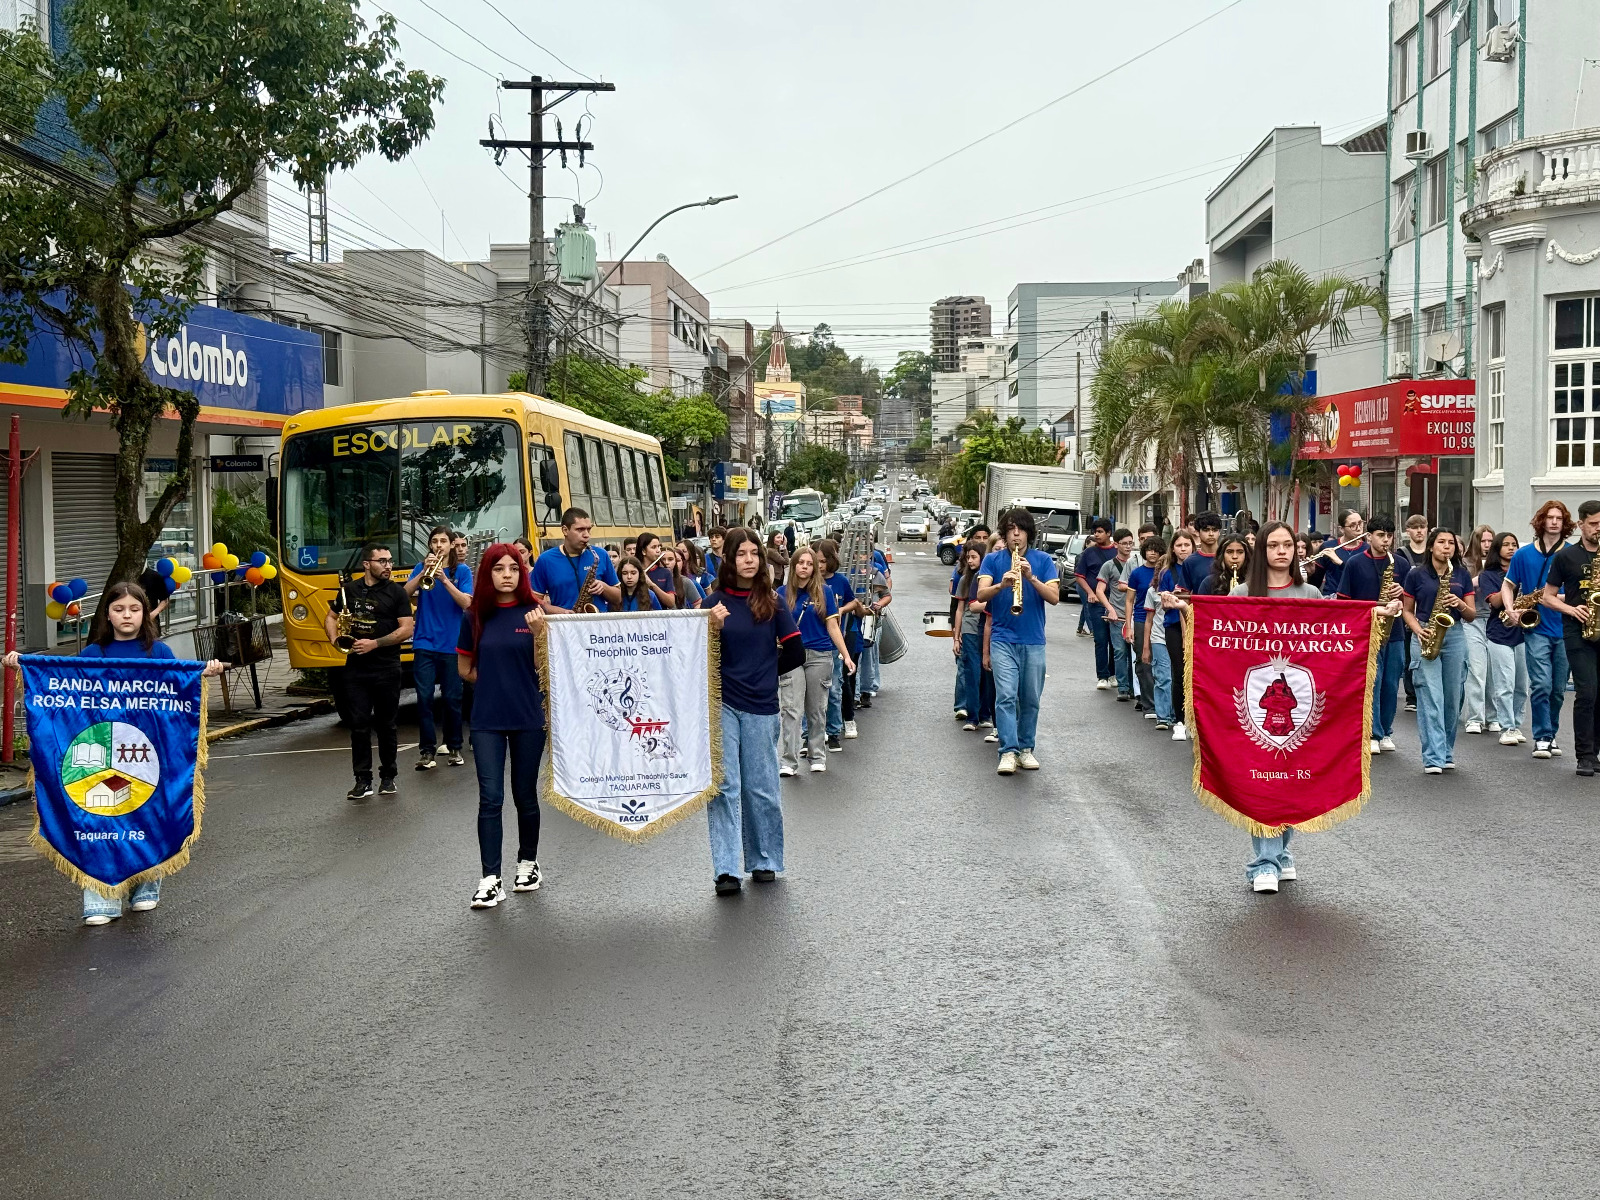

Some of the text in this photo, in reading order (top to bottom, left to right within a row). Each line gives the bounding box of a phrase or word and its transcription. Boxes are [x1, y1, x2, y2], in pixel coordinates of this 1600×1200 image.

[1420, 394, 1476, 409] SUPER
[333, 424, 473, 457] ESCOLAR
[1212, 619, 1351, 635] BANDA MARCIAL
[589, 631, 667, 644] Banda Musical
[1208, 635, 1354, 653] GETÚLIO VARGAS
[586, 645, 672, 659] Theóphilo Sauer
[48, 678, 178, 695] BANDA MARCIAL
[32, 695, 192, 713] ROSA ELSA MERTINS
[579, 776, 604, 784] Colégio
[605, 774, 635, 783] Municipal
[1249, 769, 1288, 781] Taquara
[1296, 769, 1311, 780] RS
[609, 782, 661, 792] TAQUARA/RS
[619, 815, 649, 823] FACCAT
[73, 830, 119, 842] Taquara
[128, 830, 145, 841] RS
